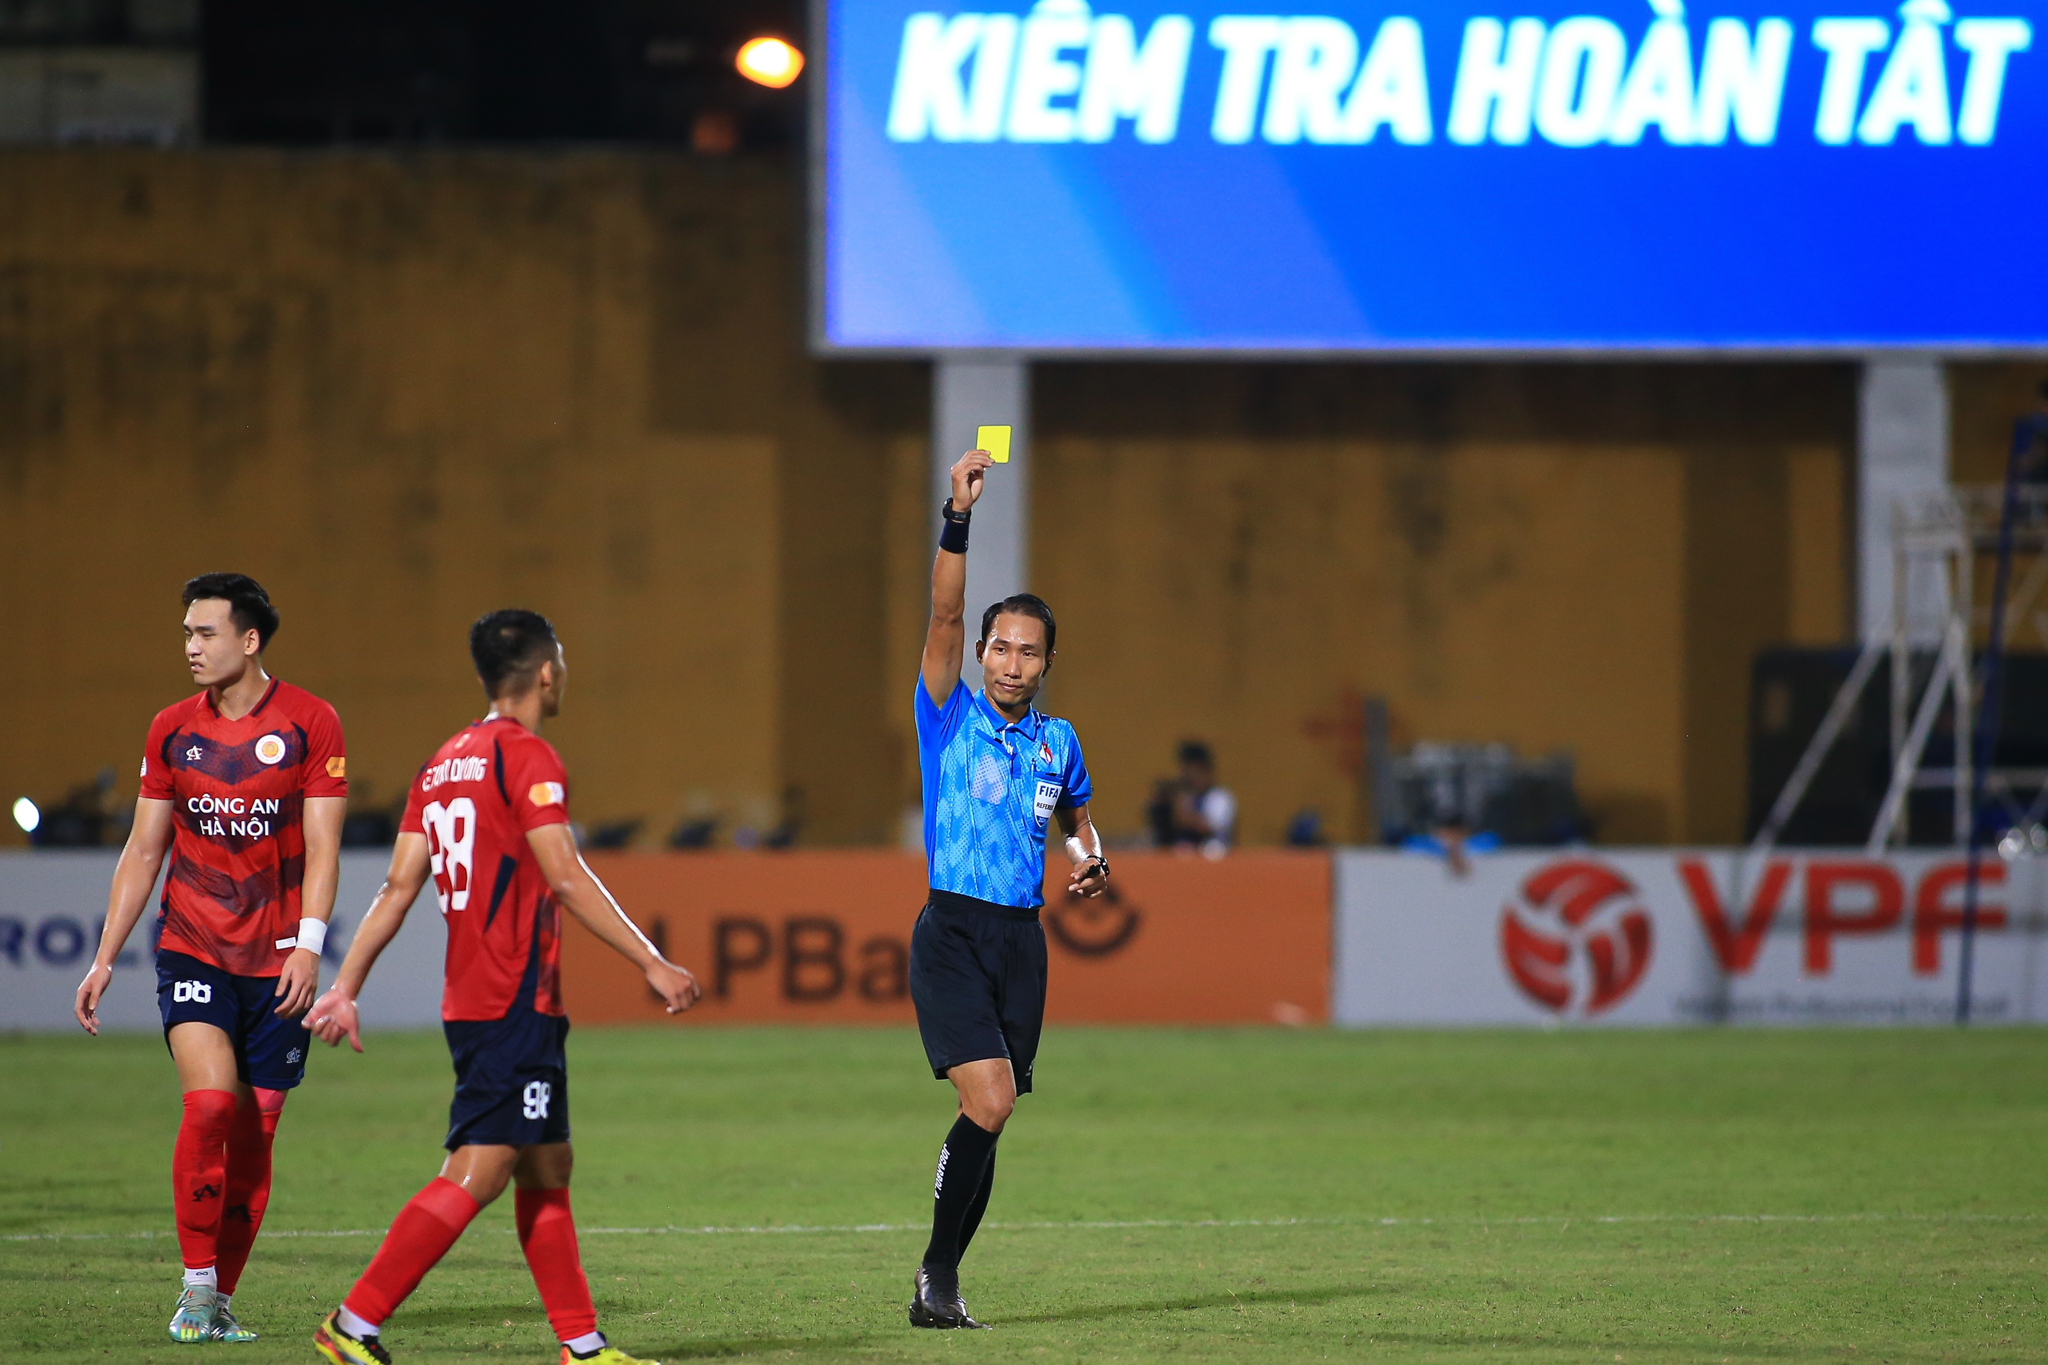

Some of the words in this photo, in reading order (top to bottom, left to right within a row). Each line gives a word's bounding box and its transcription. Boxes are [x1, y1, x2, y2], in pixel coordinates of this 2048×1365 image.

[1207, 14, 1434, 146] TRA
[1448, 0, 1794, 148] HOÀN
[187, 793, 245, 815] CÔNG
[249, 798, 280, 815] AN
[1038, 785, 1059, 799] FIFA
[199, 816, 226, 836] HÀ
[230, 816, 271, 840] NỘI
[1676, 857, 2008, 977] VPF
